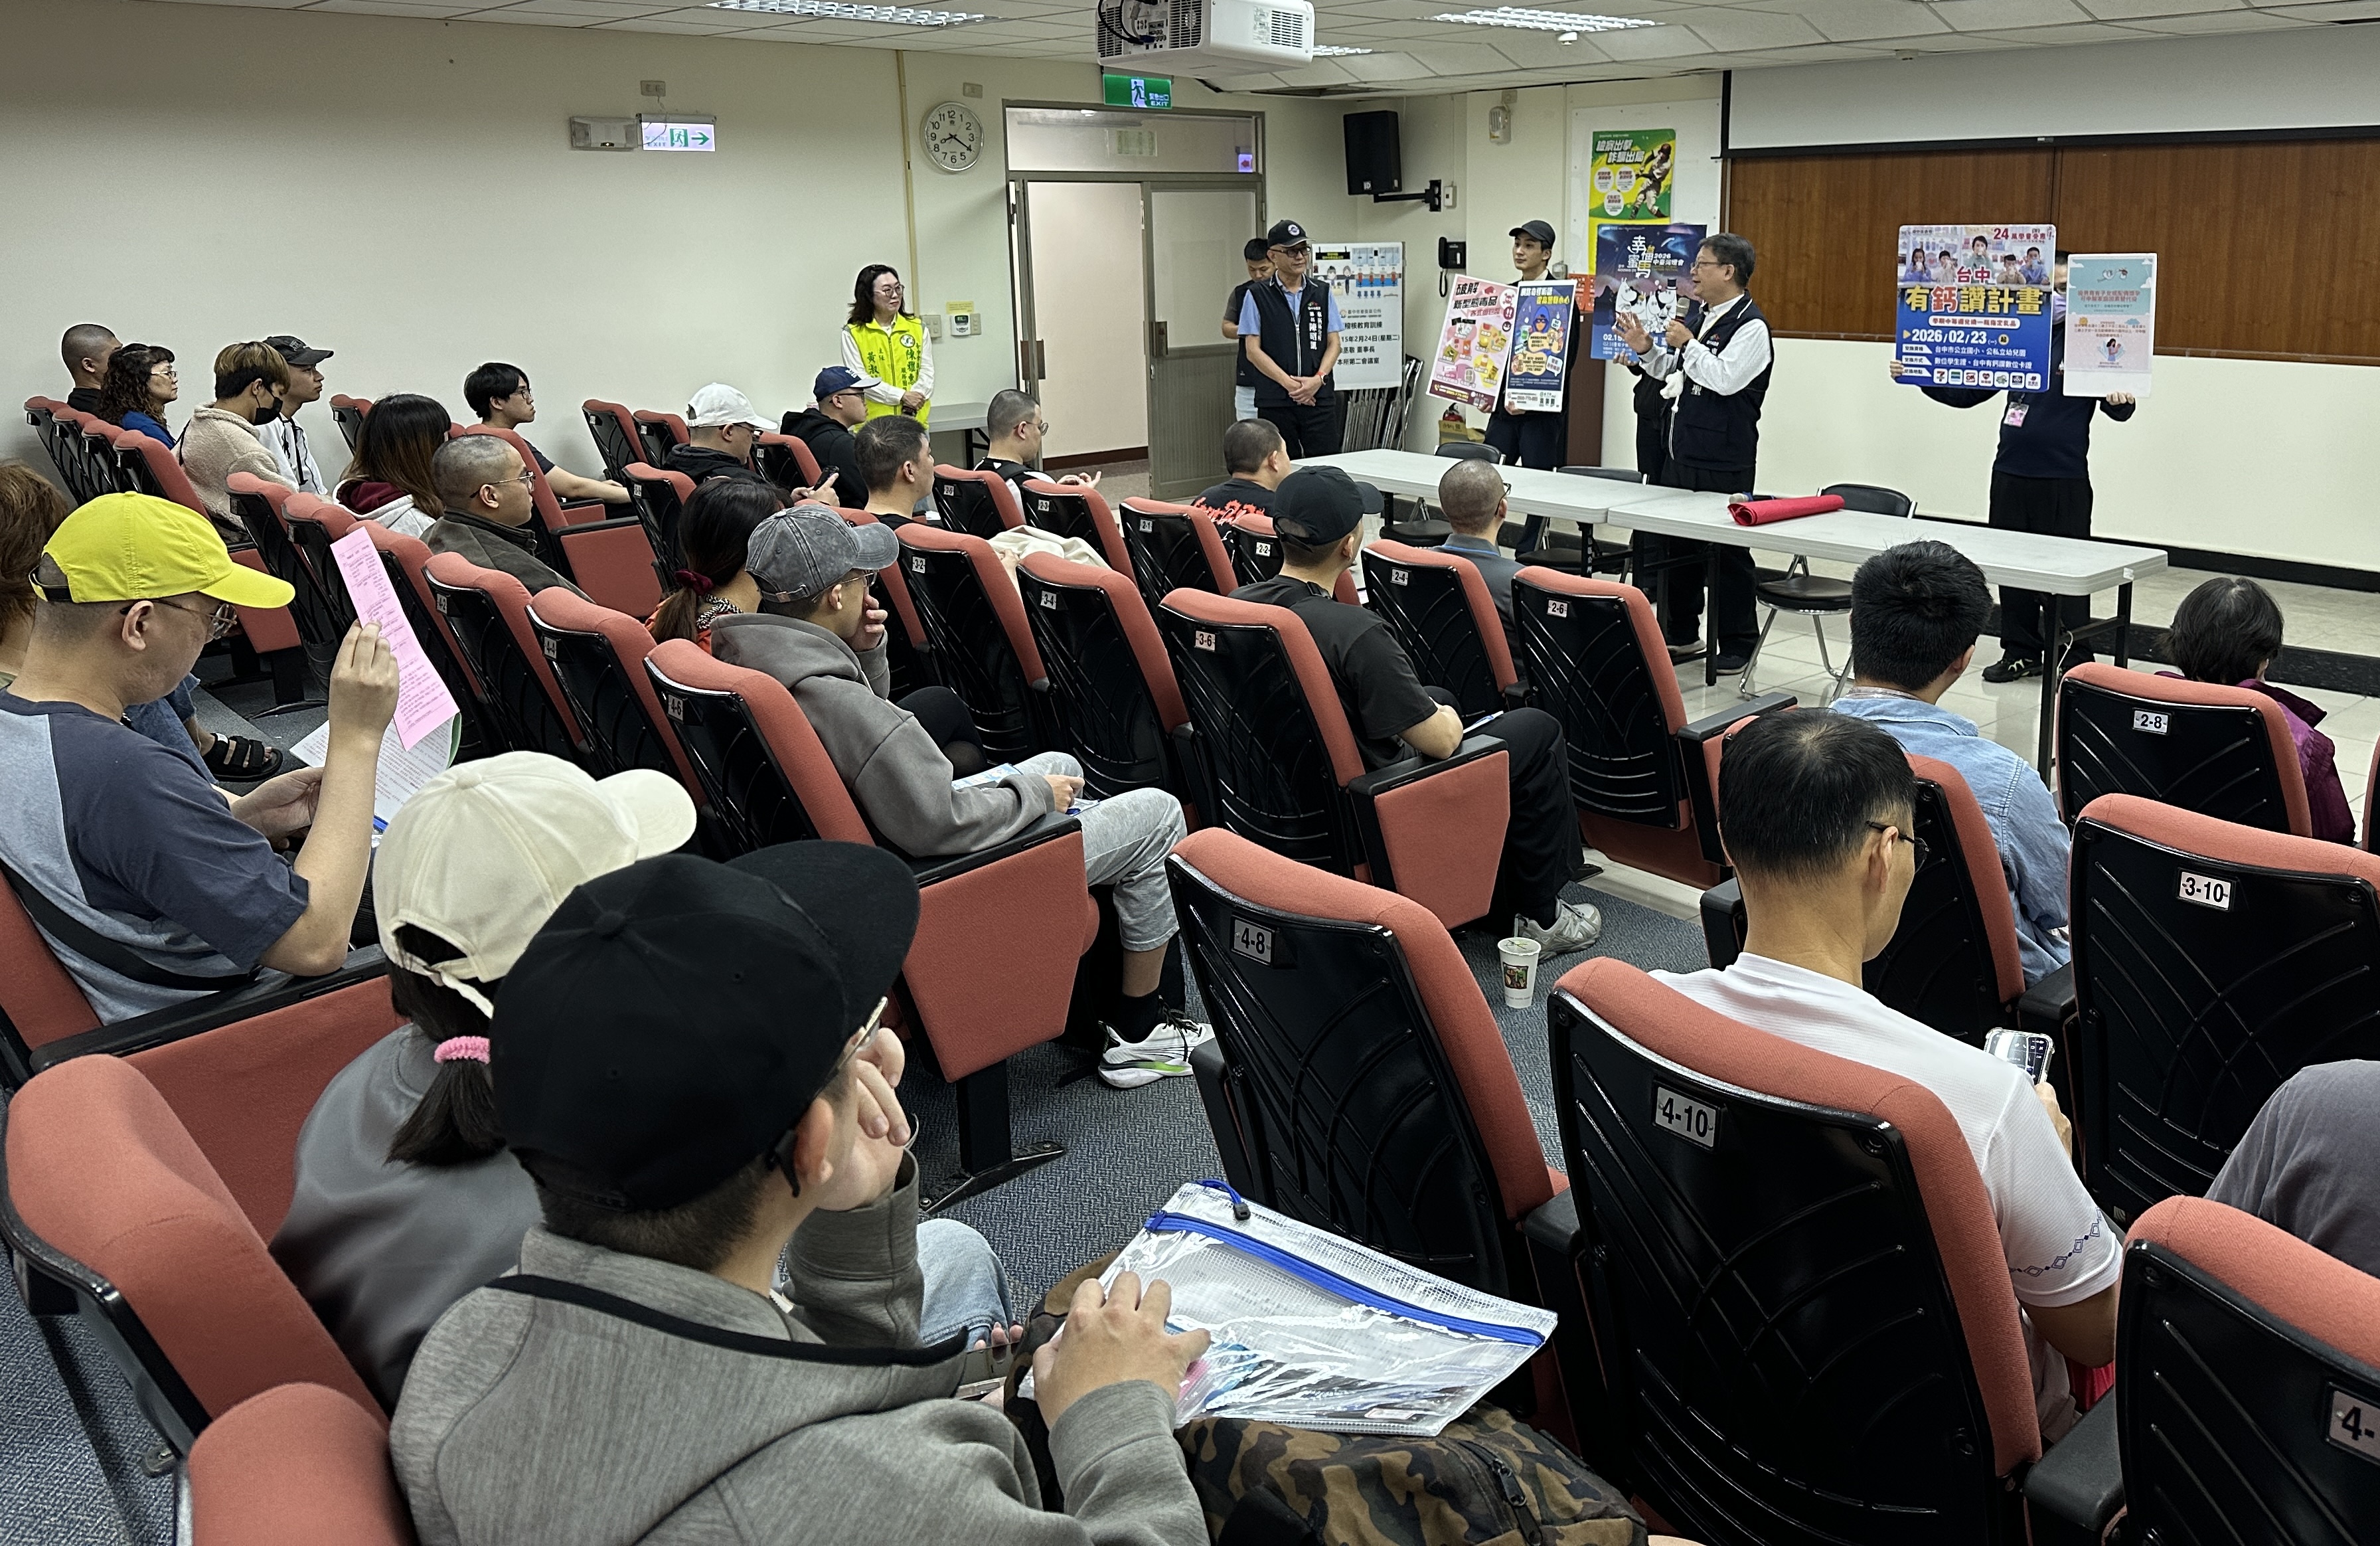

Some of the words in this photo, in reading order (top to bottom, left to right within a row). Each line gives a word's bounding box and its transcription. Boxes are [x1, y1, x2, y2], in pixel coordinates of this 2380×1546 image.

[947, 110, 956, 119] 12
[931, 121, 940, 129] 10
[969, 133, 975, 141] 3
[933, 143, 940, 152] 8
[941, 151, 947, 160] 7
[1957, 266, 1991, 282] 台中
[1905, 286, 2043, 315] 有鈣讚計畫
[1142, 521, 1151, 530] 2-1
[1259, 545, 1269, 554] 2-2
[915, 558, 923, 570] 3-2
[1395, 572, 1406, 582] 2-4
[1043, 593, 1055, 606] 3-4
[1551, 602, 1564, 614] 2-6
[1198, 633, 1212, 647] 3-6
[546, 640, 556, 655] 4-4
[671, 697, 682, 715] 4-6
[2140, 713, 2163, 730] 2-8
[2184, 876, 2225, 903] 3-10
[1240, 927, 1266, 954] 4-8
[1662, 1096, 1709, 1138] 4-10
